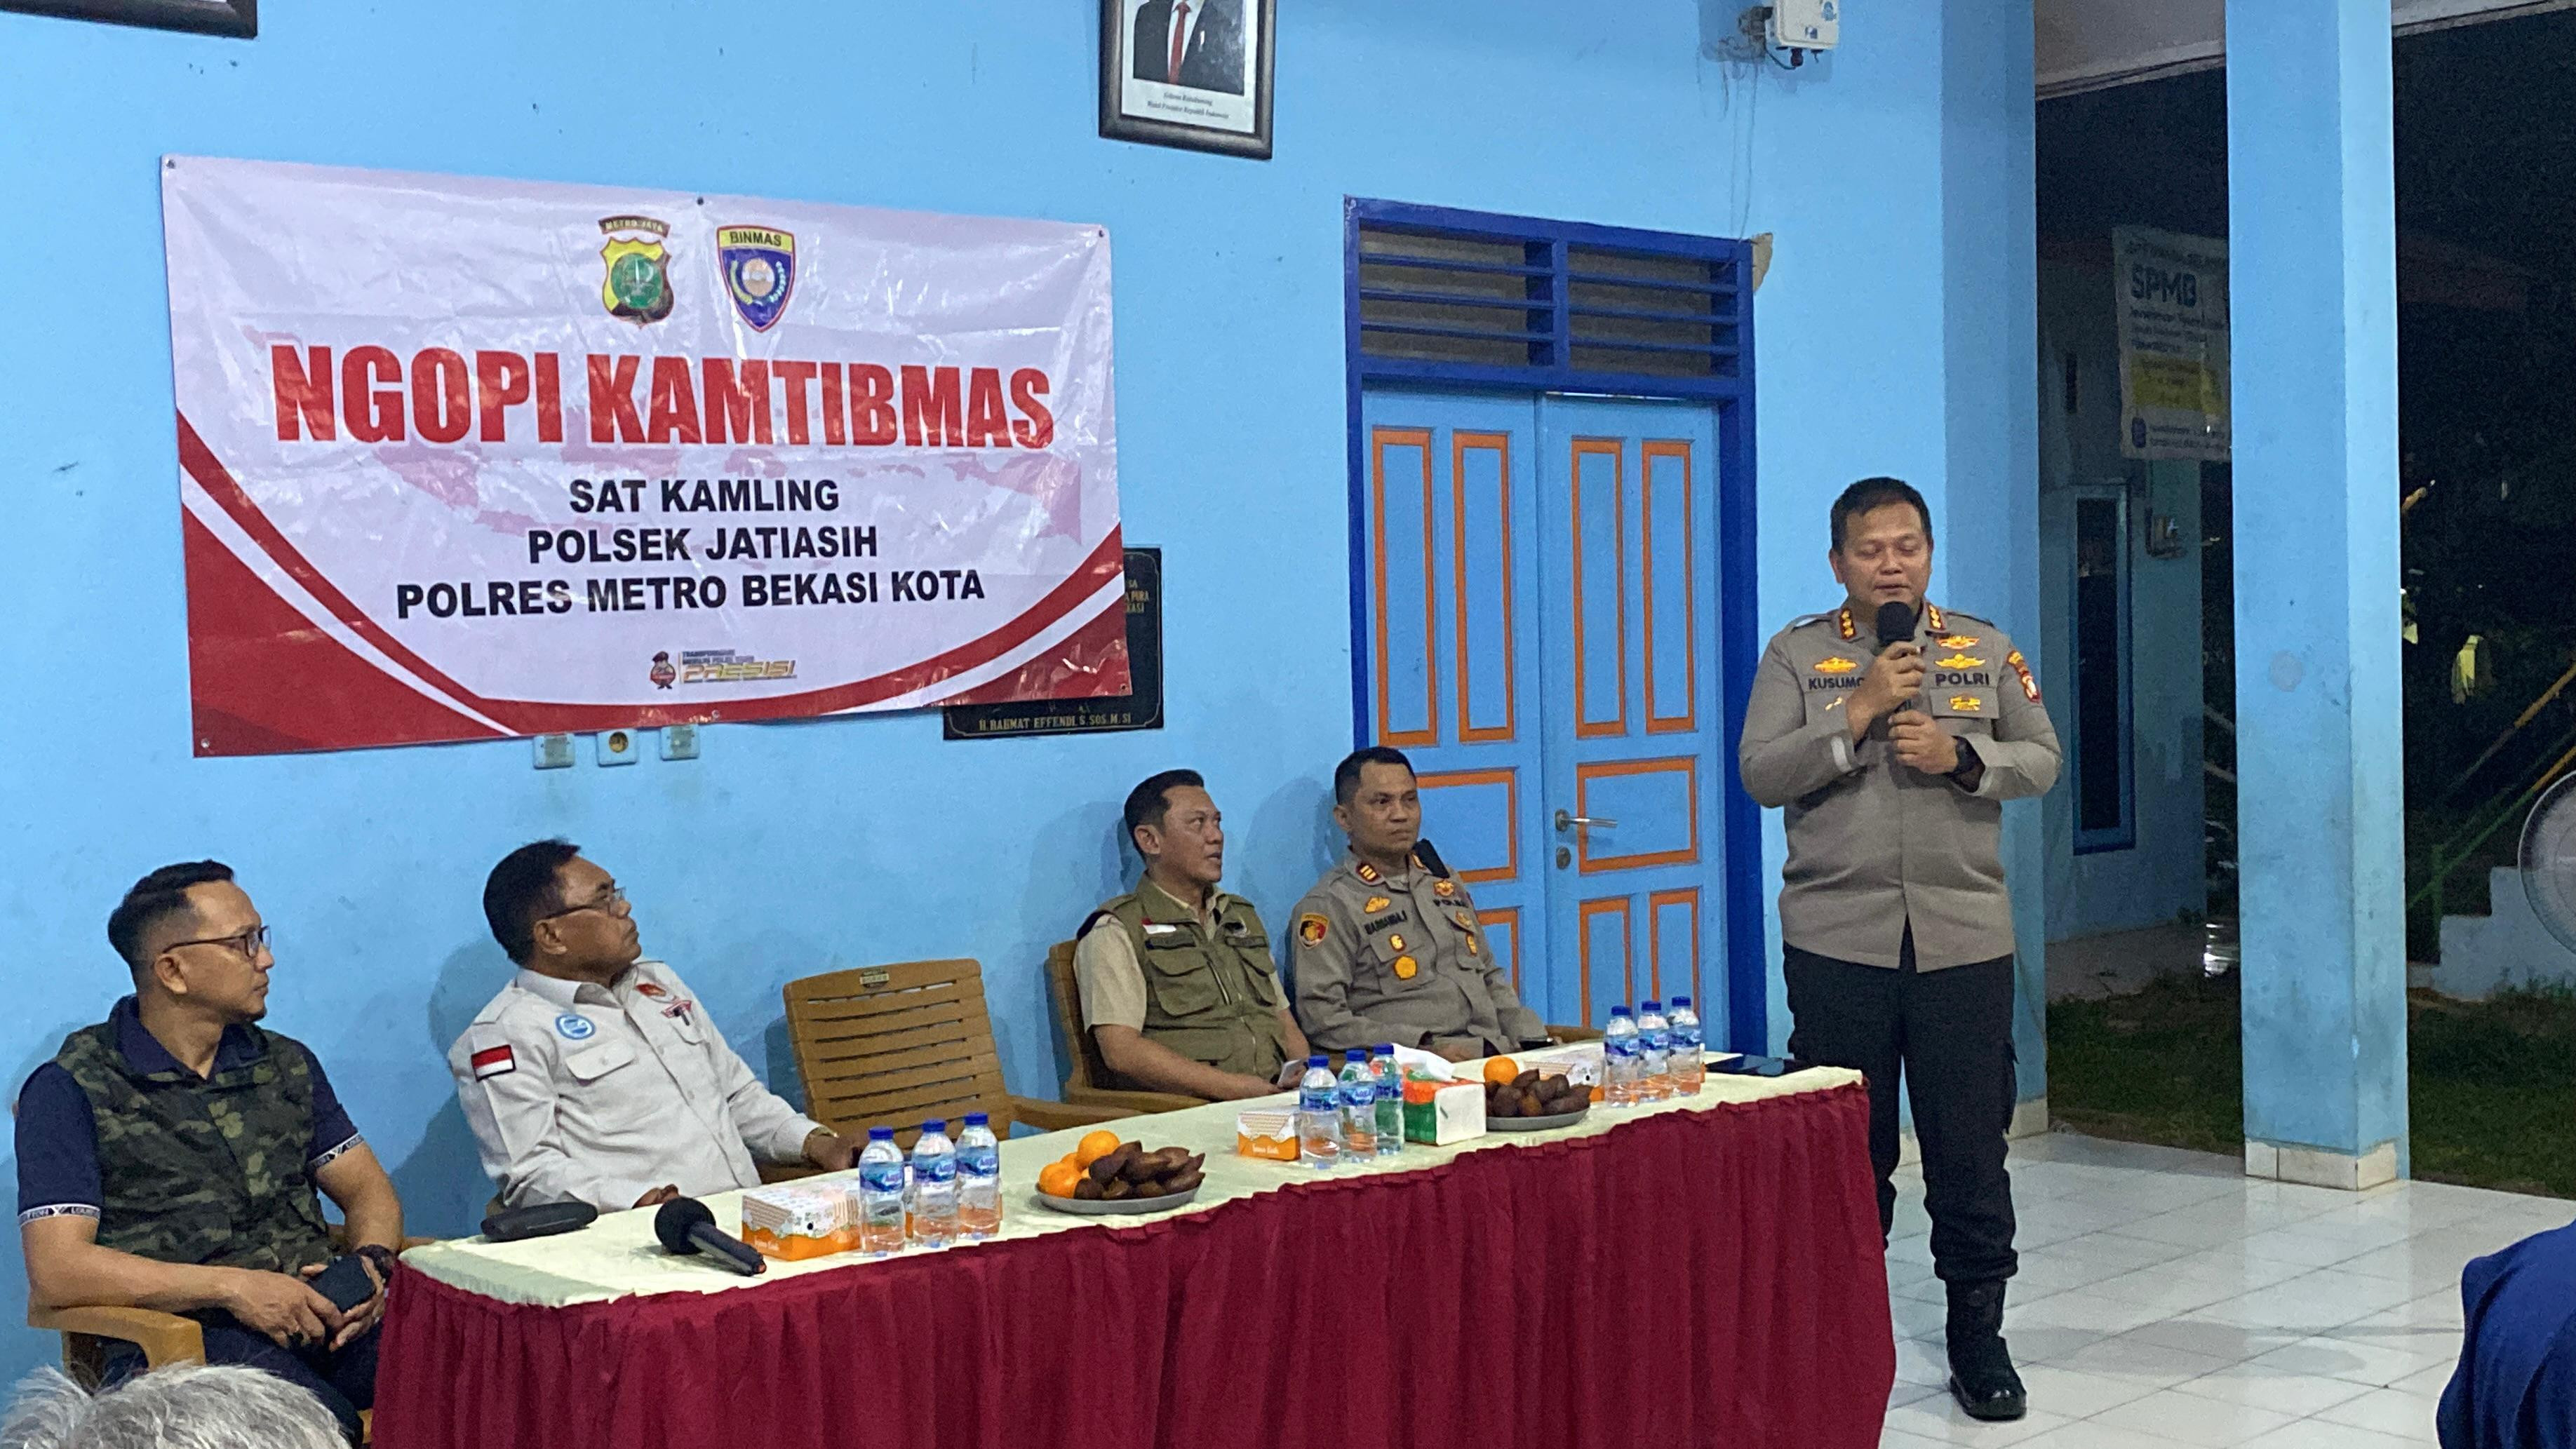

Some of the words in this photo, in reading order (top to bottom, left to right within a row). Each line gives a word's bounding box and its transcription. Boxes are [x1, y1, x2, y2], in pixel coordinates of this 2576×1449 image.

[730, 231, 781, 246] BINMAS
[2131, 263, 2196, 308] SPMB
[271, 344, 563, 443] NGOPI
[586, 353, 1054, 450] KAMTIBMAS
[569, 479, 646, 513] SAT
[661, 479, 839, 513] KAMLING
[528, 528, 692, 564] POLSEK
[706, 525, 878, 560] JATIASIH
[396, 579, 573, 619] POLRES
[586, 575, 727, 612] METRO
[742, 572, 878, 607] BEKASI
[891, 569, 986, 602] KOTA
[1935, 673, 1990, 686] POLRI
